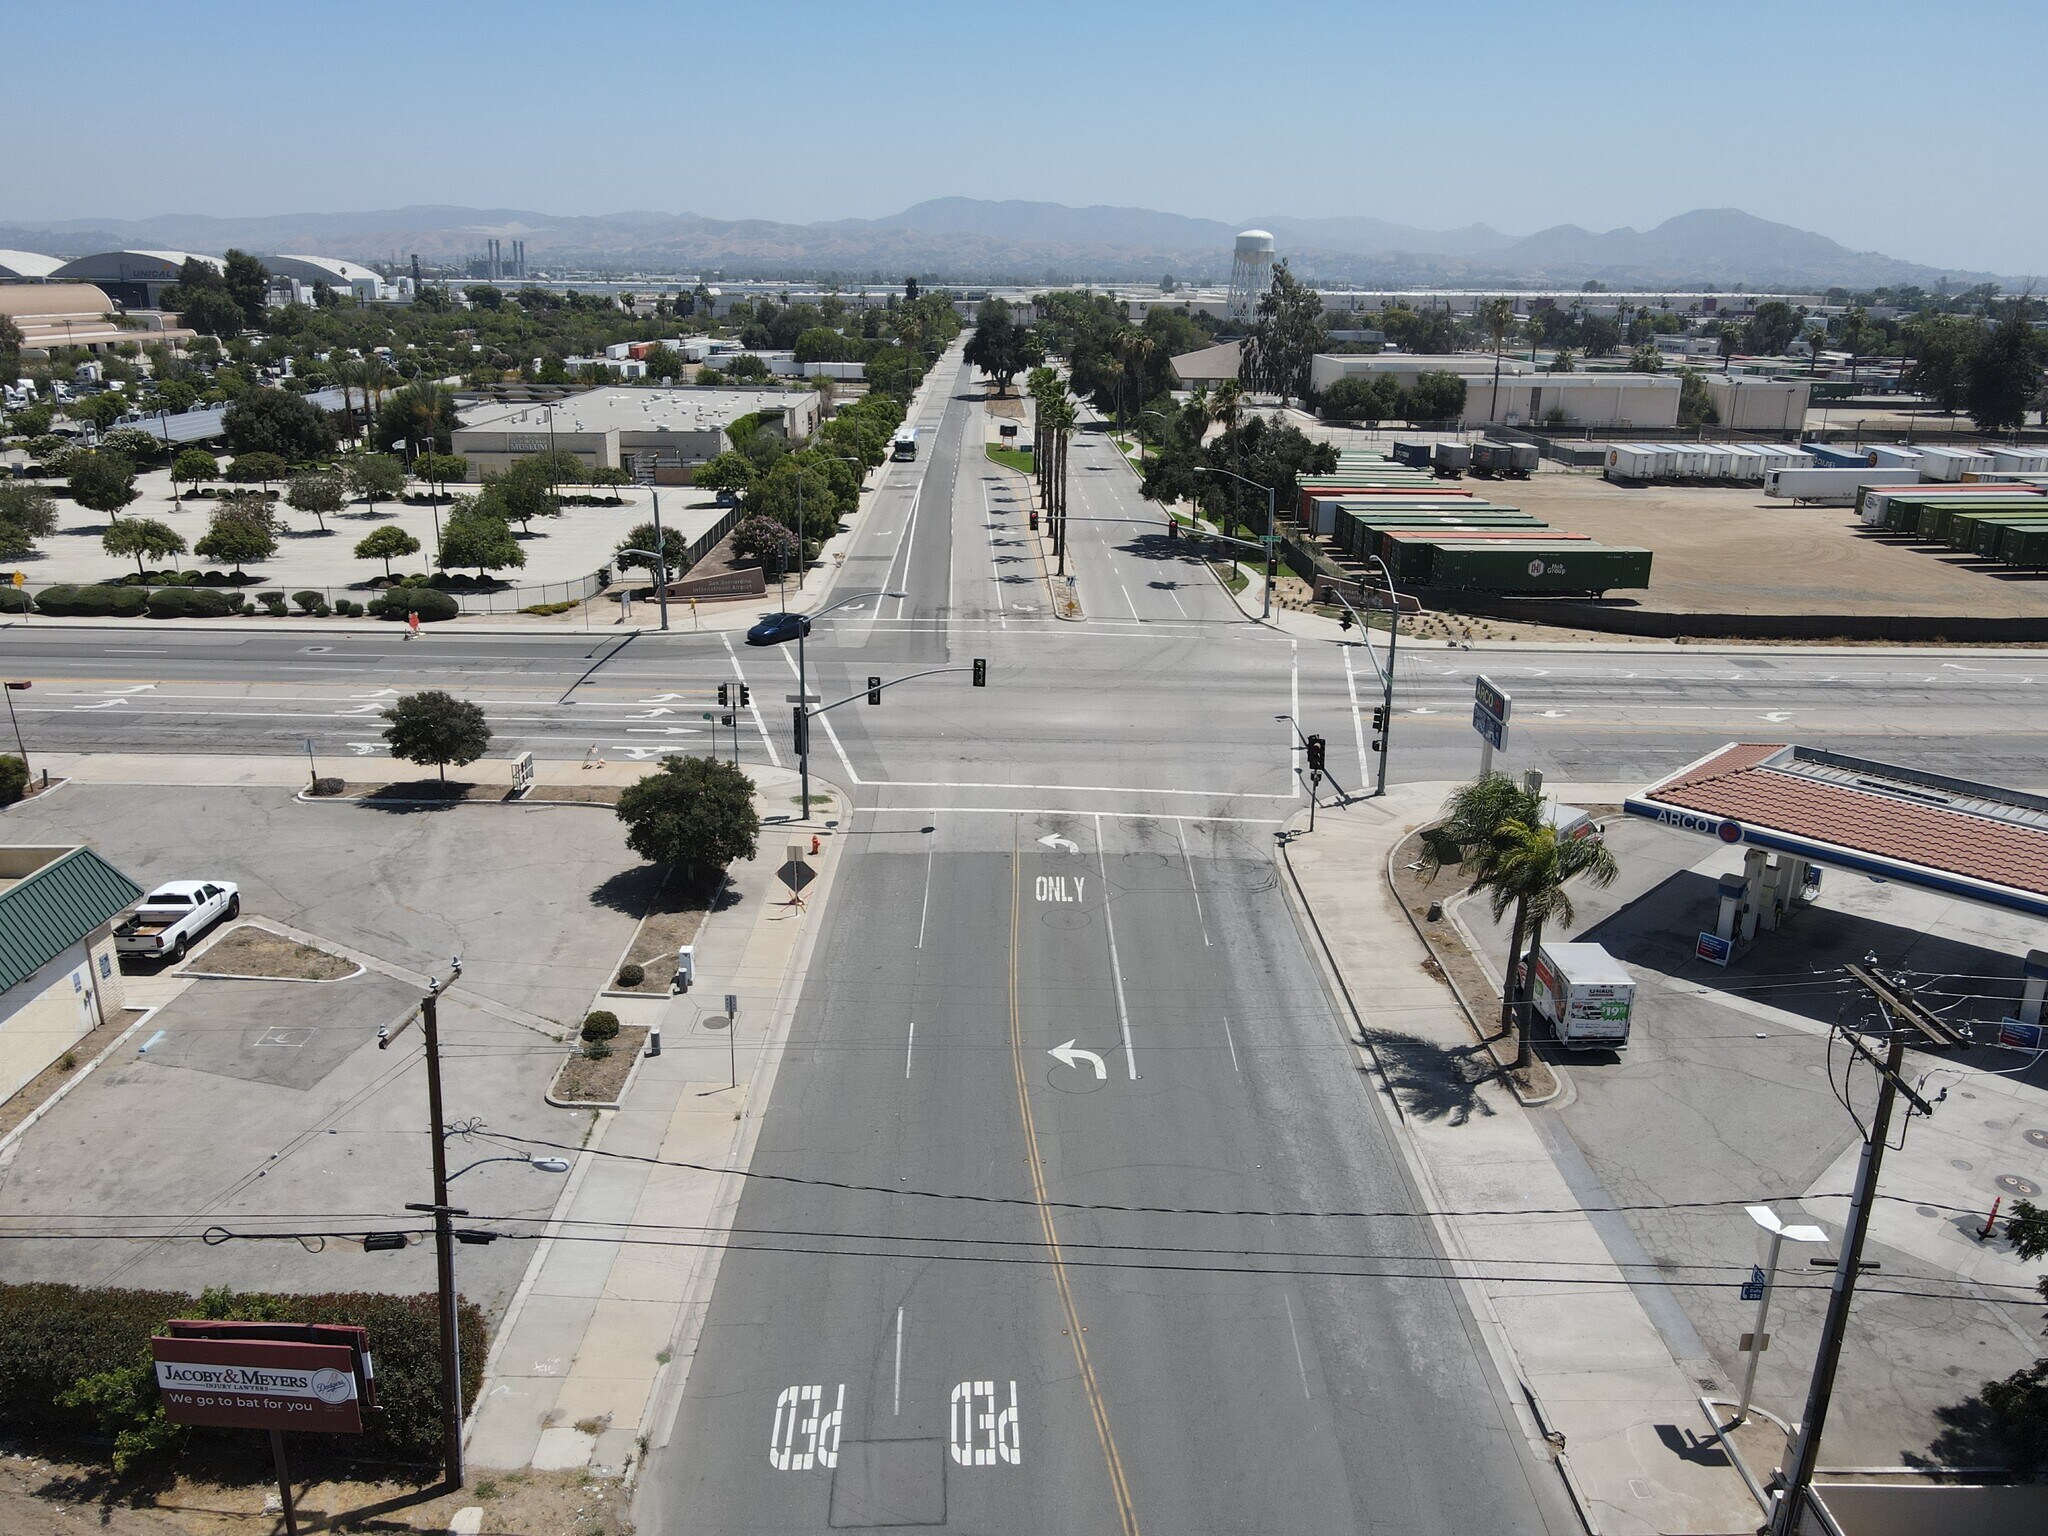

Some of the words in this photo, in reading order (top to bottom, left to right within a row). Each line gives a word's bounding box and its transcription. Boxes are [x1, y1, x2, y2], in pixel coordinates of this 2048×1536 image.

[133, 270, 172, 278] UNICAL
[511, 443, 548, 451] MUSEUM
[693, 584, 730, 592] International
[1476, 684, 1494, 708] ARCO
[1656, 808, 1709, 833] ARCO
[1035, 876, 1085, 903] ONLY
[205, 1382, 232, 1390] INJURY
[234, 1384, 269, 1392] LAWYERS
[316, 1379, 346, 1392] Dodgers
[169, 1393, 192, 1404] We
[197, 1396, 214, 1407] go
[217, 1396, 232, 1406] to
[237, 1397, 260, 1408] bat
[264, 1398, 283, 1409] for
[287, 1402, 312, 1413] you
[769, 1383, 845, 1471] PED
[950, 1380, 1021, 1467] PED
